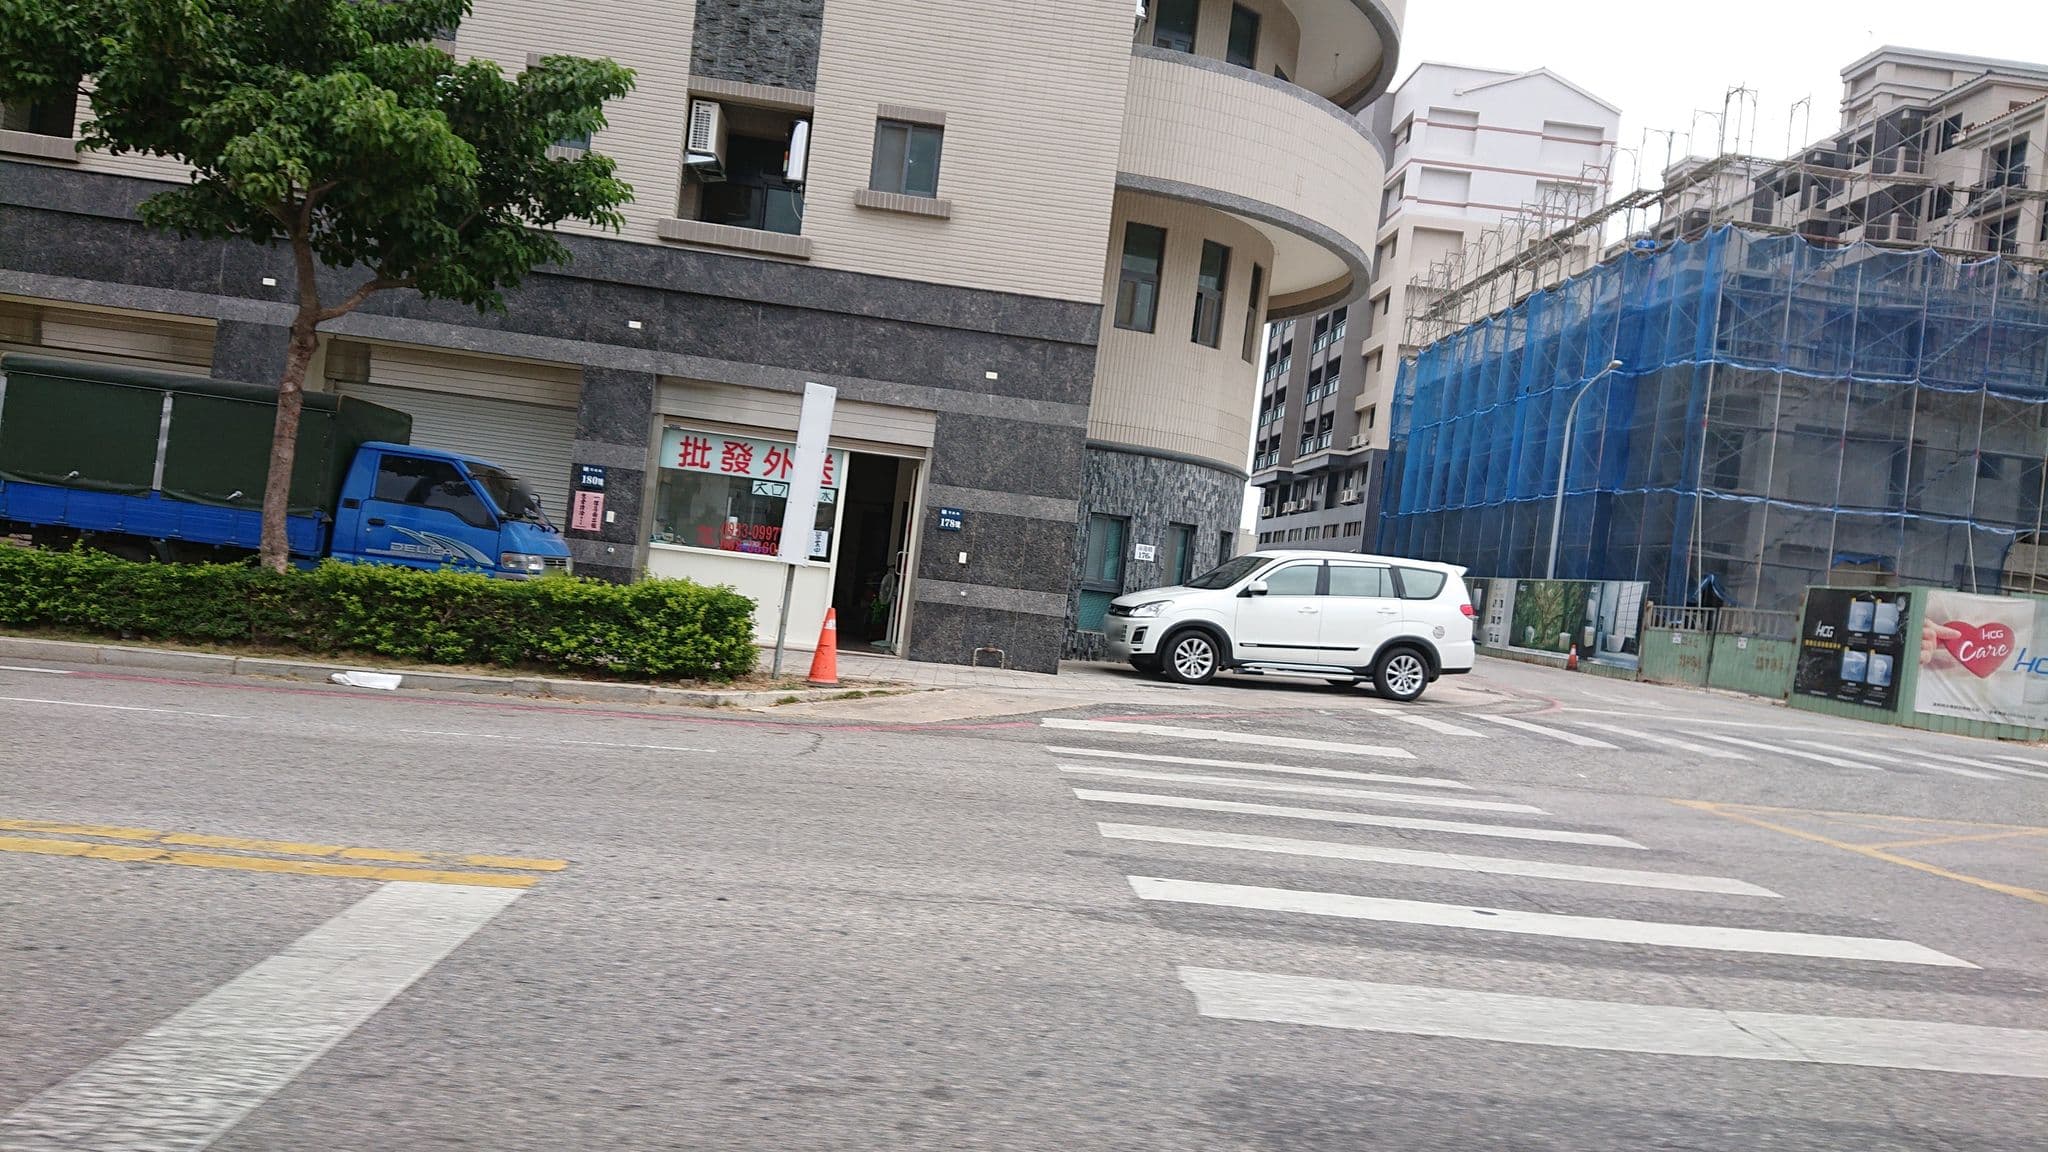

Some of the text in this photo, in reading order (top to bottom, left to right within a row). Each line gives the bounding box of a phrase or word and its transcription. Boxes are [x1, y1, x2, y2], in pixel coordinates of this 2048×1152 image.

[1815, 620, 1835, 638] HCG
[1982, 628, 2005, 640] HCG
[1960, 640, 2009, 662] Care
